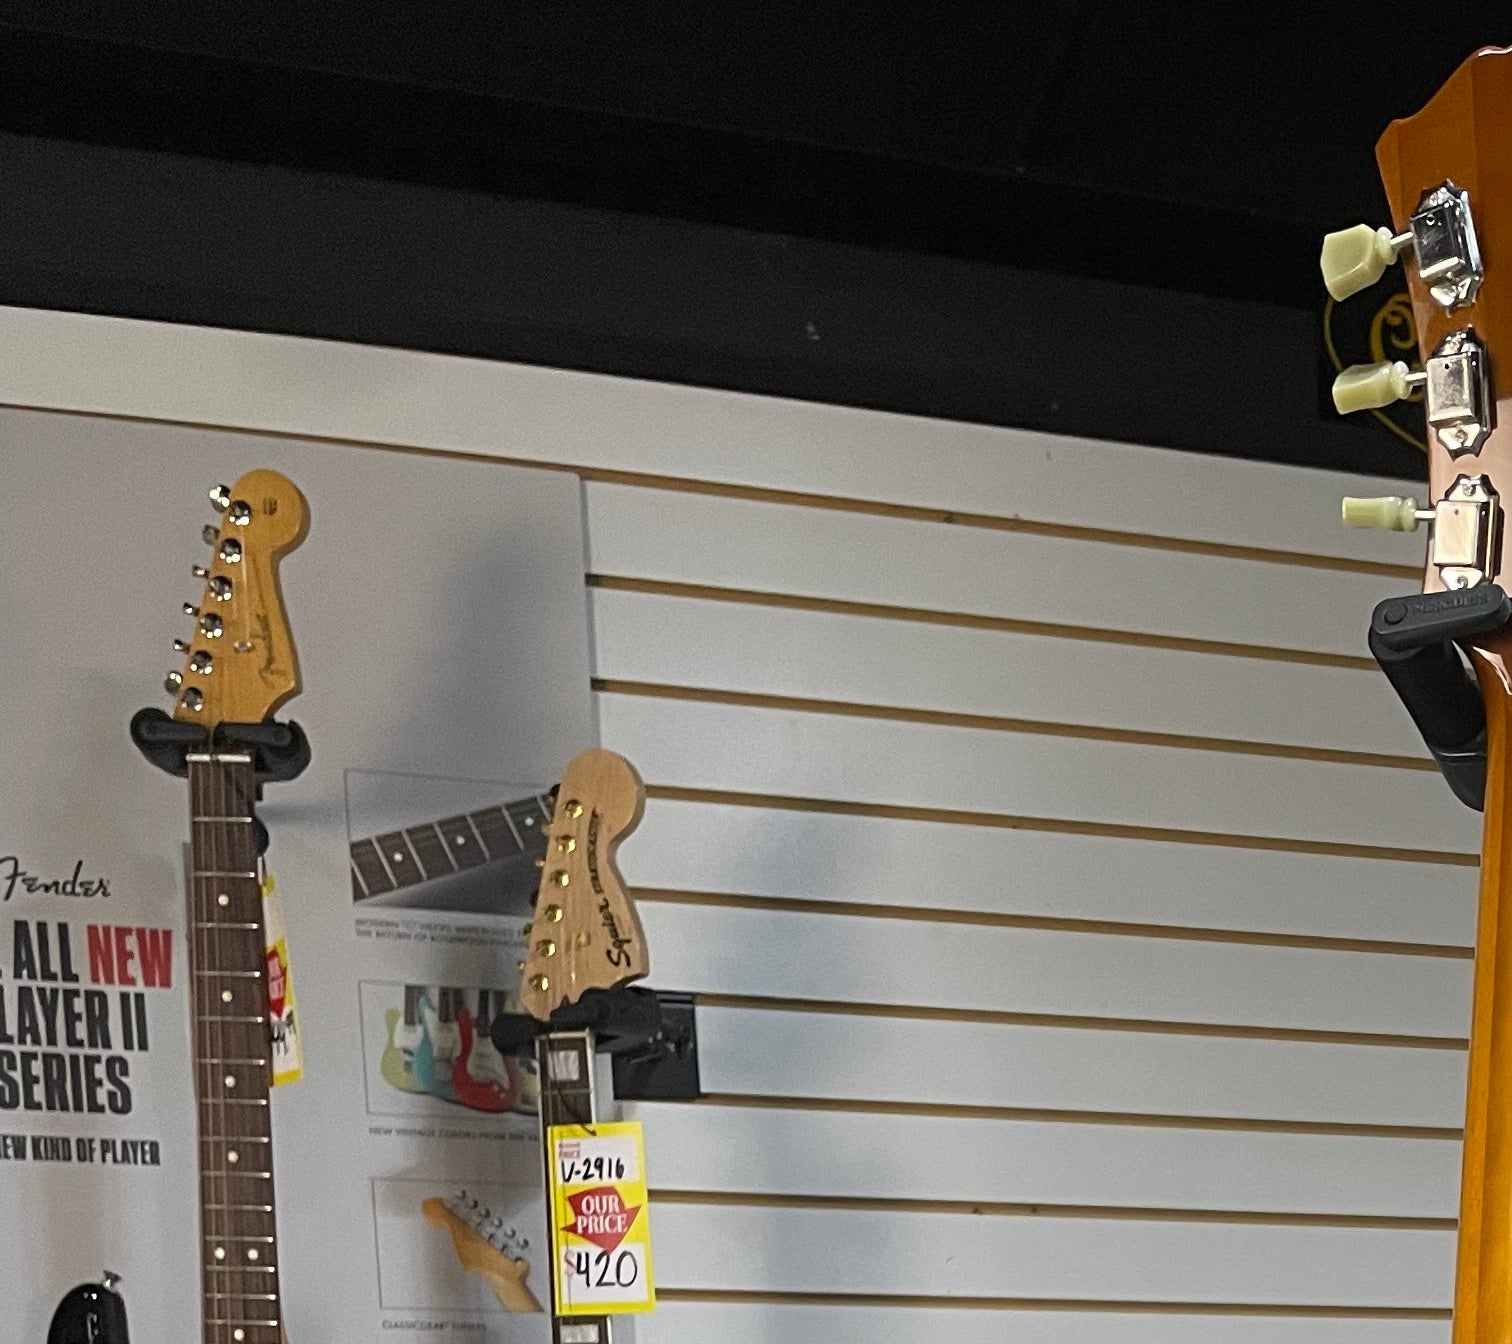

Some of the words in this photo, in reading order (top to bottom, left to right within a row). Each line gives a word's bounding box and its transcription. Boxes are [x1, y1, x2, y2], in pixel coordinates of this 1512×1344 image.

[0, 856, 111, 901] Fender
[13, 919, 79, 983] ALL
[87, 924, 172, 989] NEW
[119, 990, 149, 1052] II
[0, 1050, 132, 1115] SERIES
[0, 1134, 27, 1161] EW
[31, 1135, 72, 1162] KIND
[75, 1137, 96, 1163] OF
[100, 1138, 161, 1166] PLAYER
[576, 1212, 628, 1235] PRICE
[581, 1193, 620, 1215] OUR
[564, 1250, 638, 1289] $420
